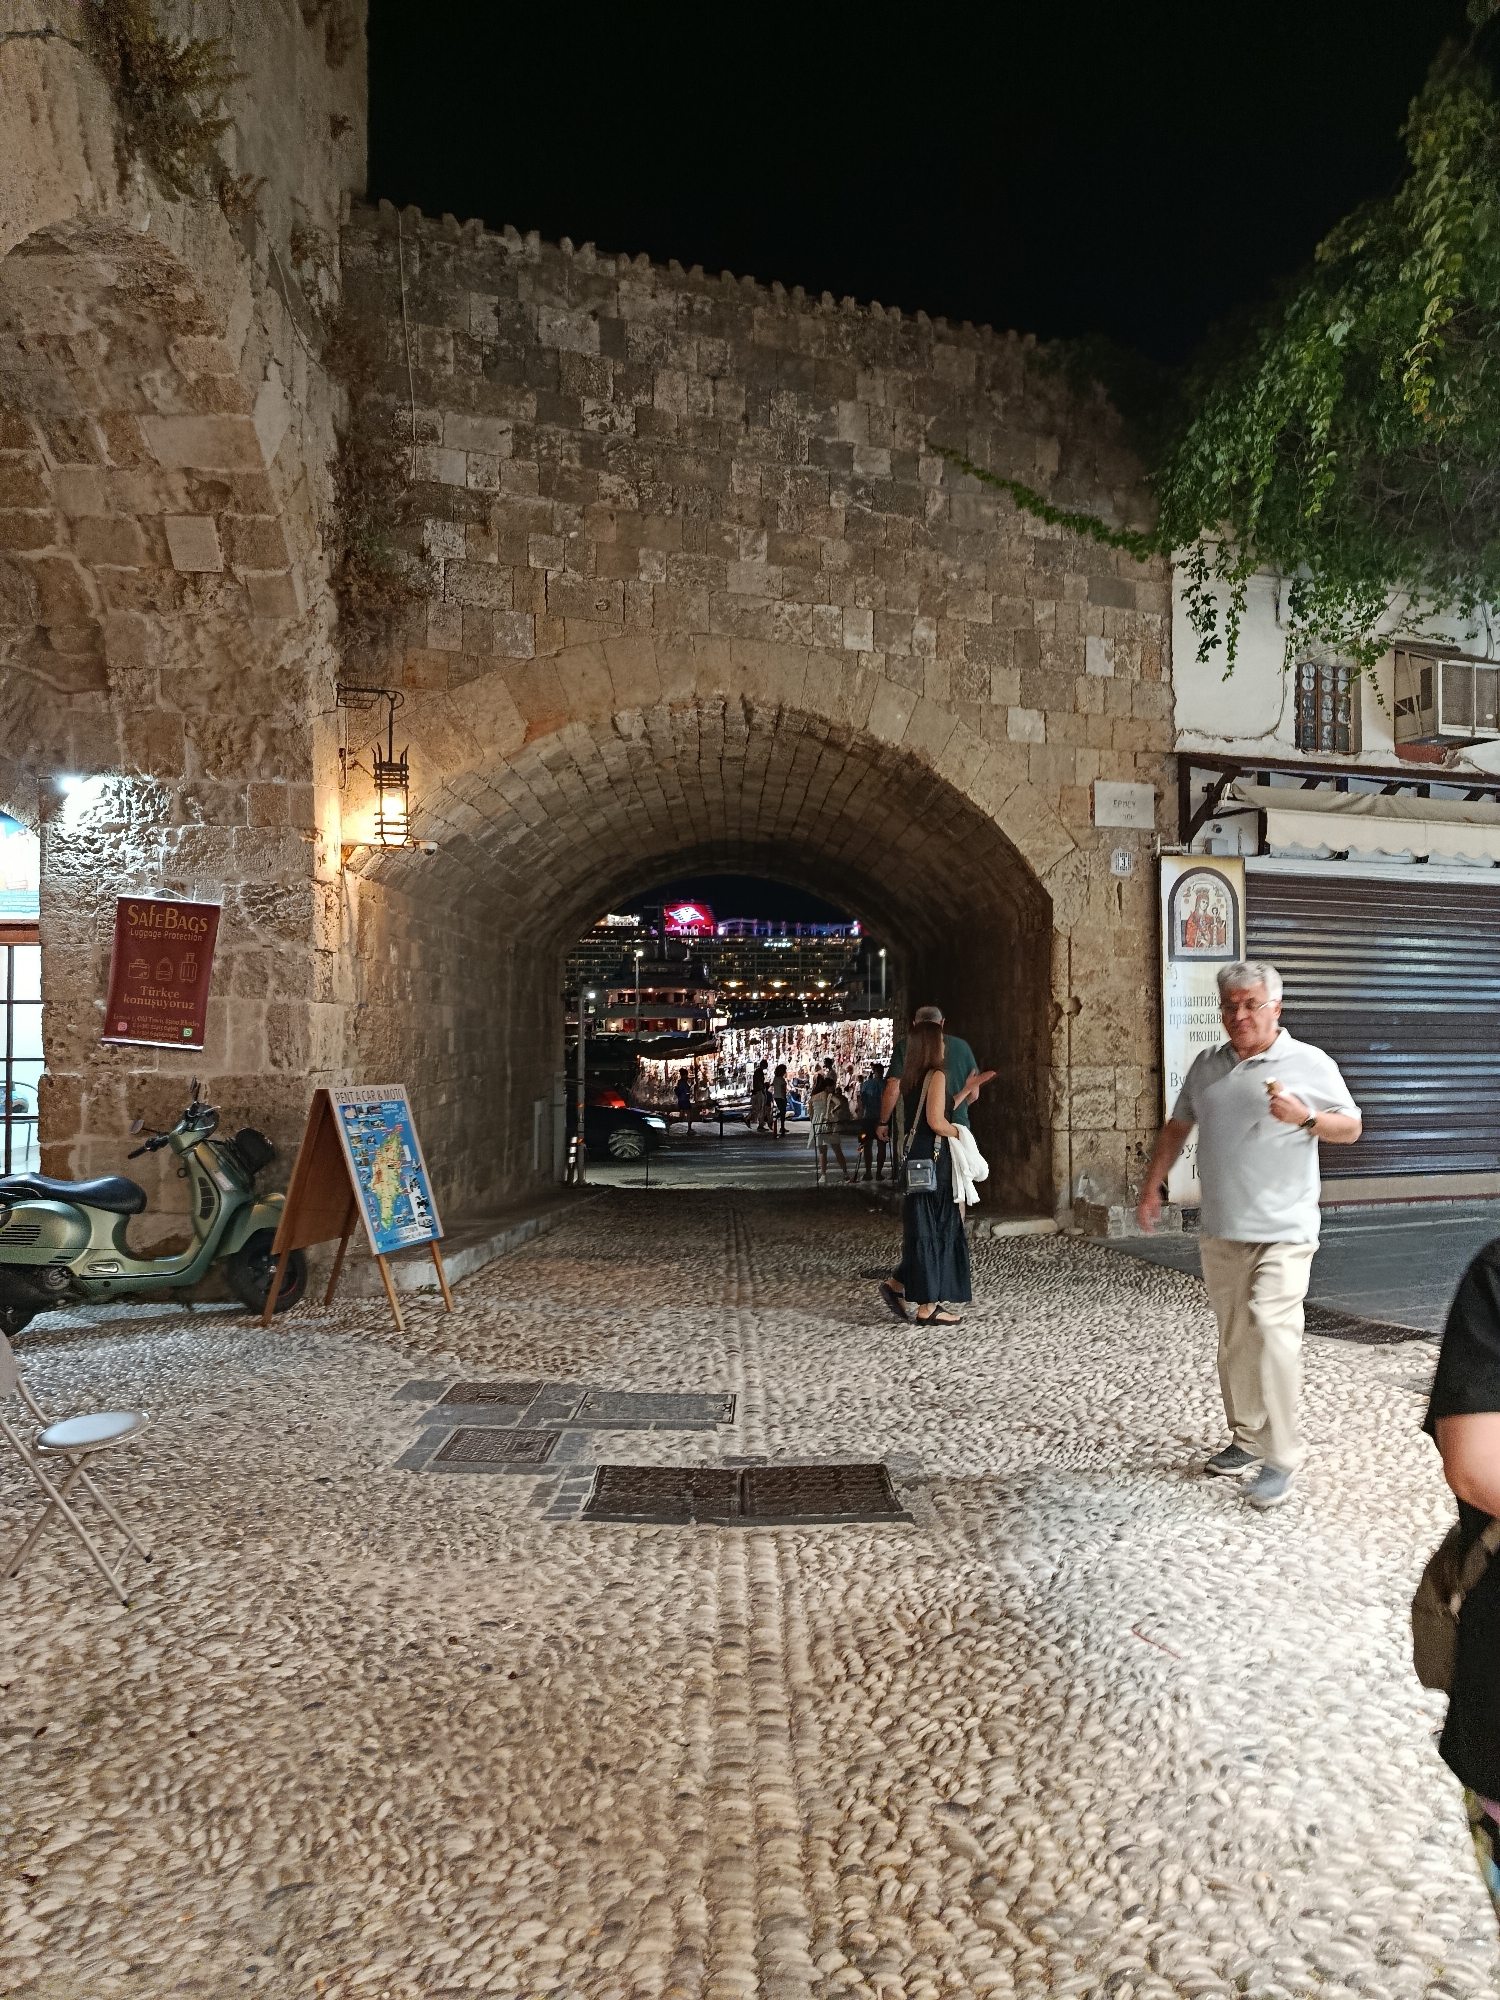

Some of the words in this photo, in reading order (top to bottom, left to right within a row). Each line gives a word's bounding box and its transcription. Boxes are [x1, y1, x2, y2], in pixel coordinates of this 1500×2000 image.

[130, 928, 162, 940] Luggage
[164, 930, 203, 942] Protection
[140, 985, 180, 999] Türkçe
[123, 994, 195, 1010] konuşuyoruz
[1169, 1013, 1222, 1029] православ
[1189, 1031, 1221, 1042] иконы
[335, 1091, 354, 1104] RENT
[356, 1091, 362, 1103] A
[362, 1090, 377, 1103] CAR
[377, 1089, 384, 1101] &
[383, 1088, 404, 1101] MOTO
